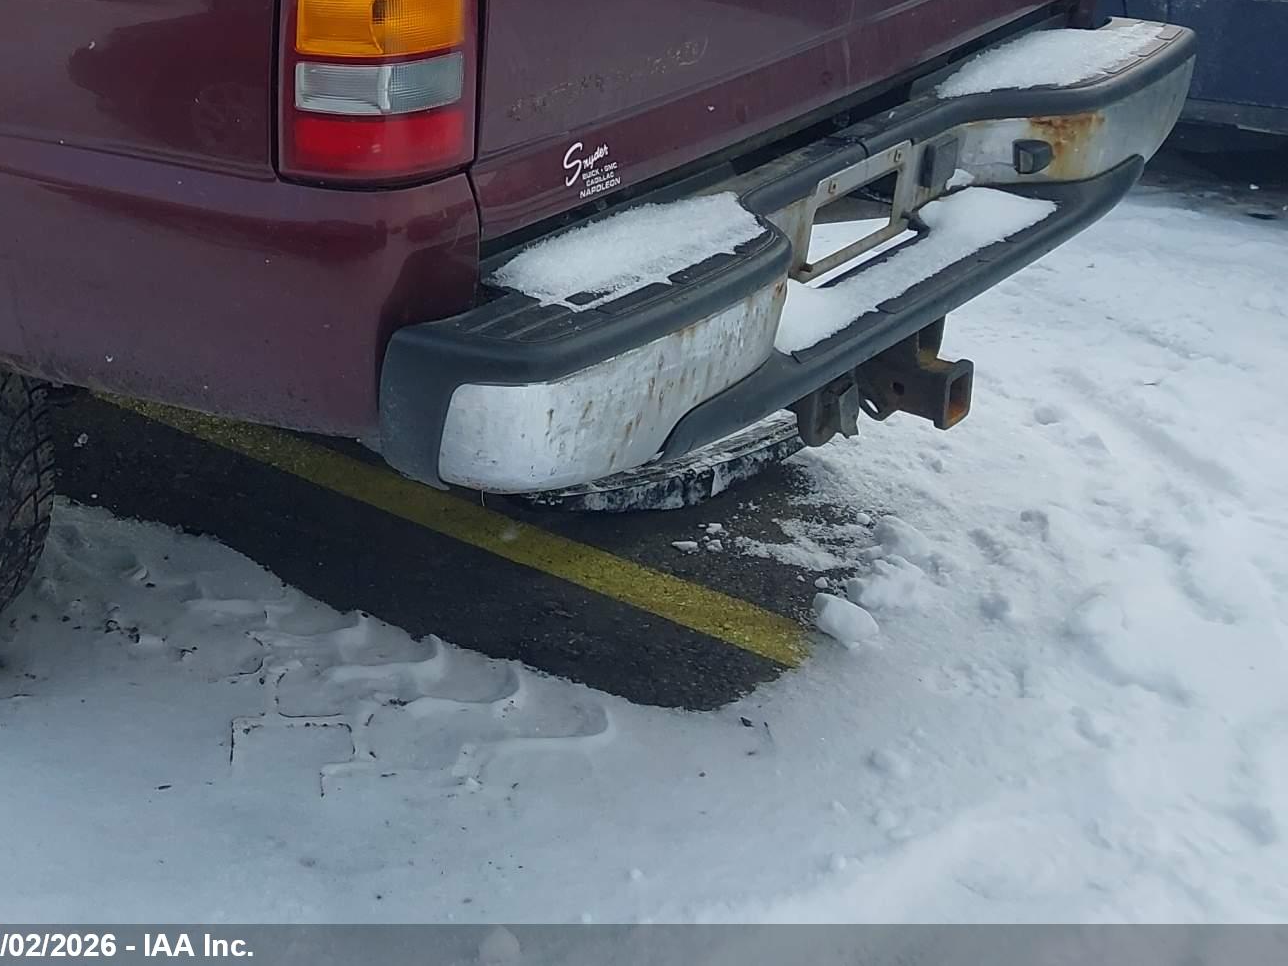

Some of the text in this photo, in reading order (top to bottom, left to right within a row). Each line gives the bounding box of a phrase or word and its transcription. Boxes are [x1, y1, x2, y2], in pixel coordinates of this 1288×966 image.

[563, 142, 609, 186] Snyder
[582, 161, 618, 180] BUICK GMC
[579, 176, 622, 199] NAPOLEON
[585, 171, 615, 187] CADILLAC
